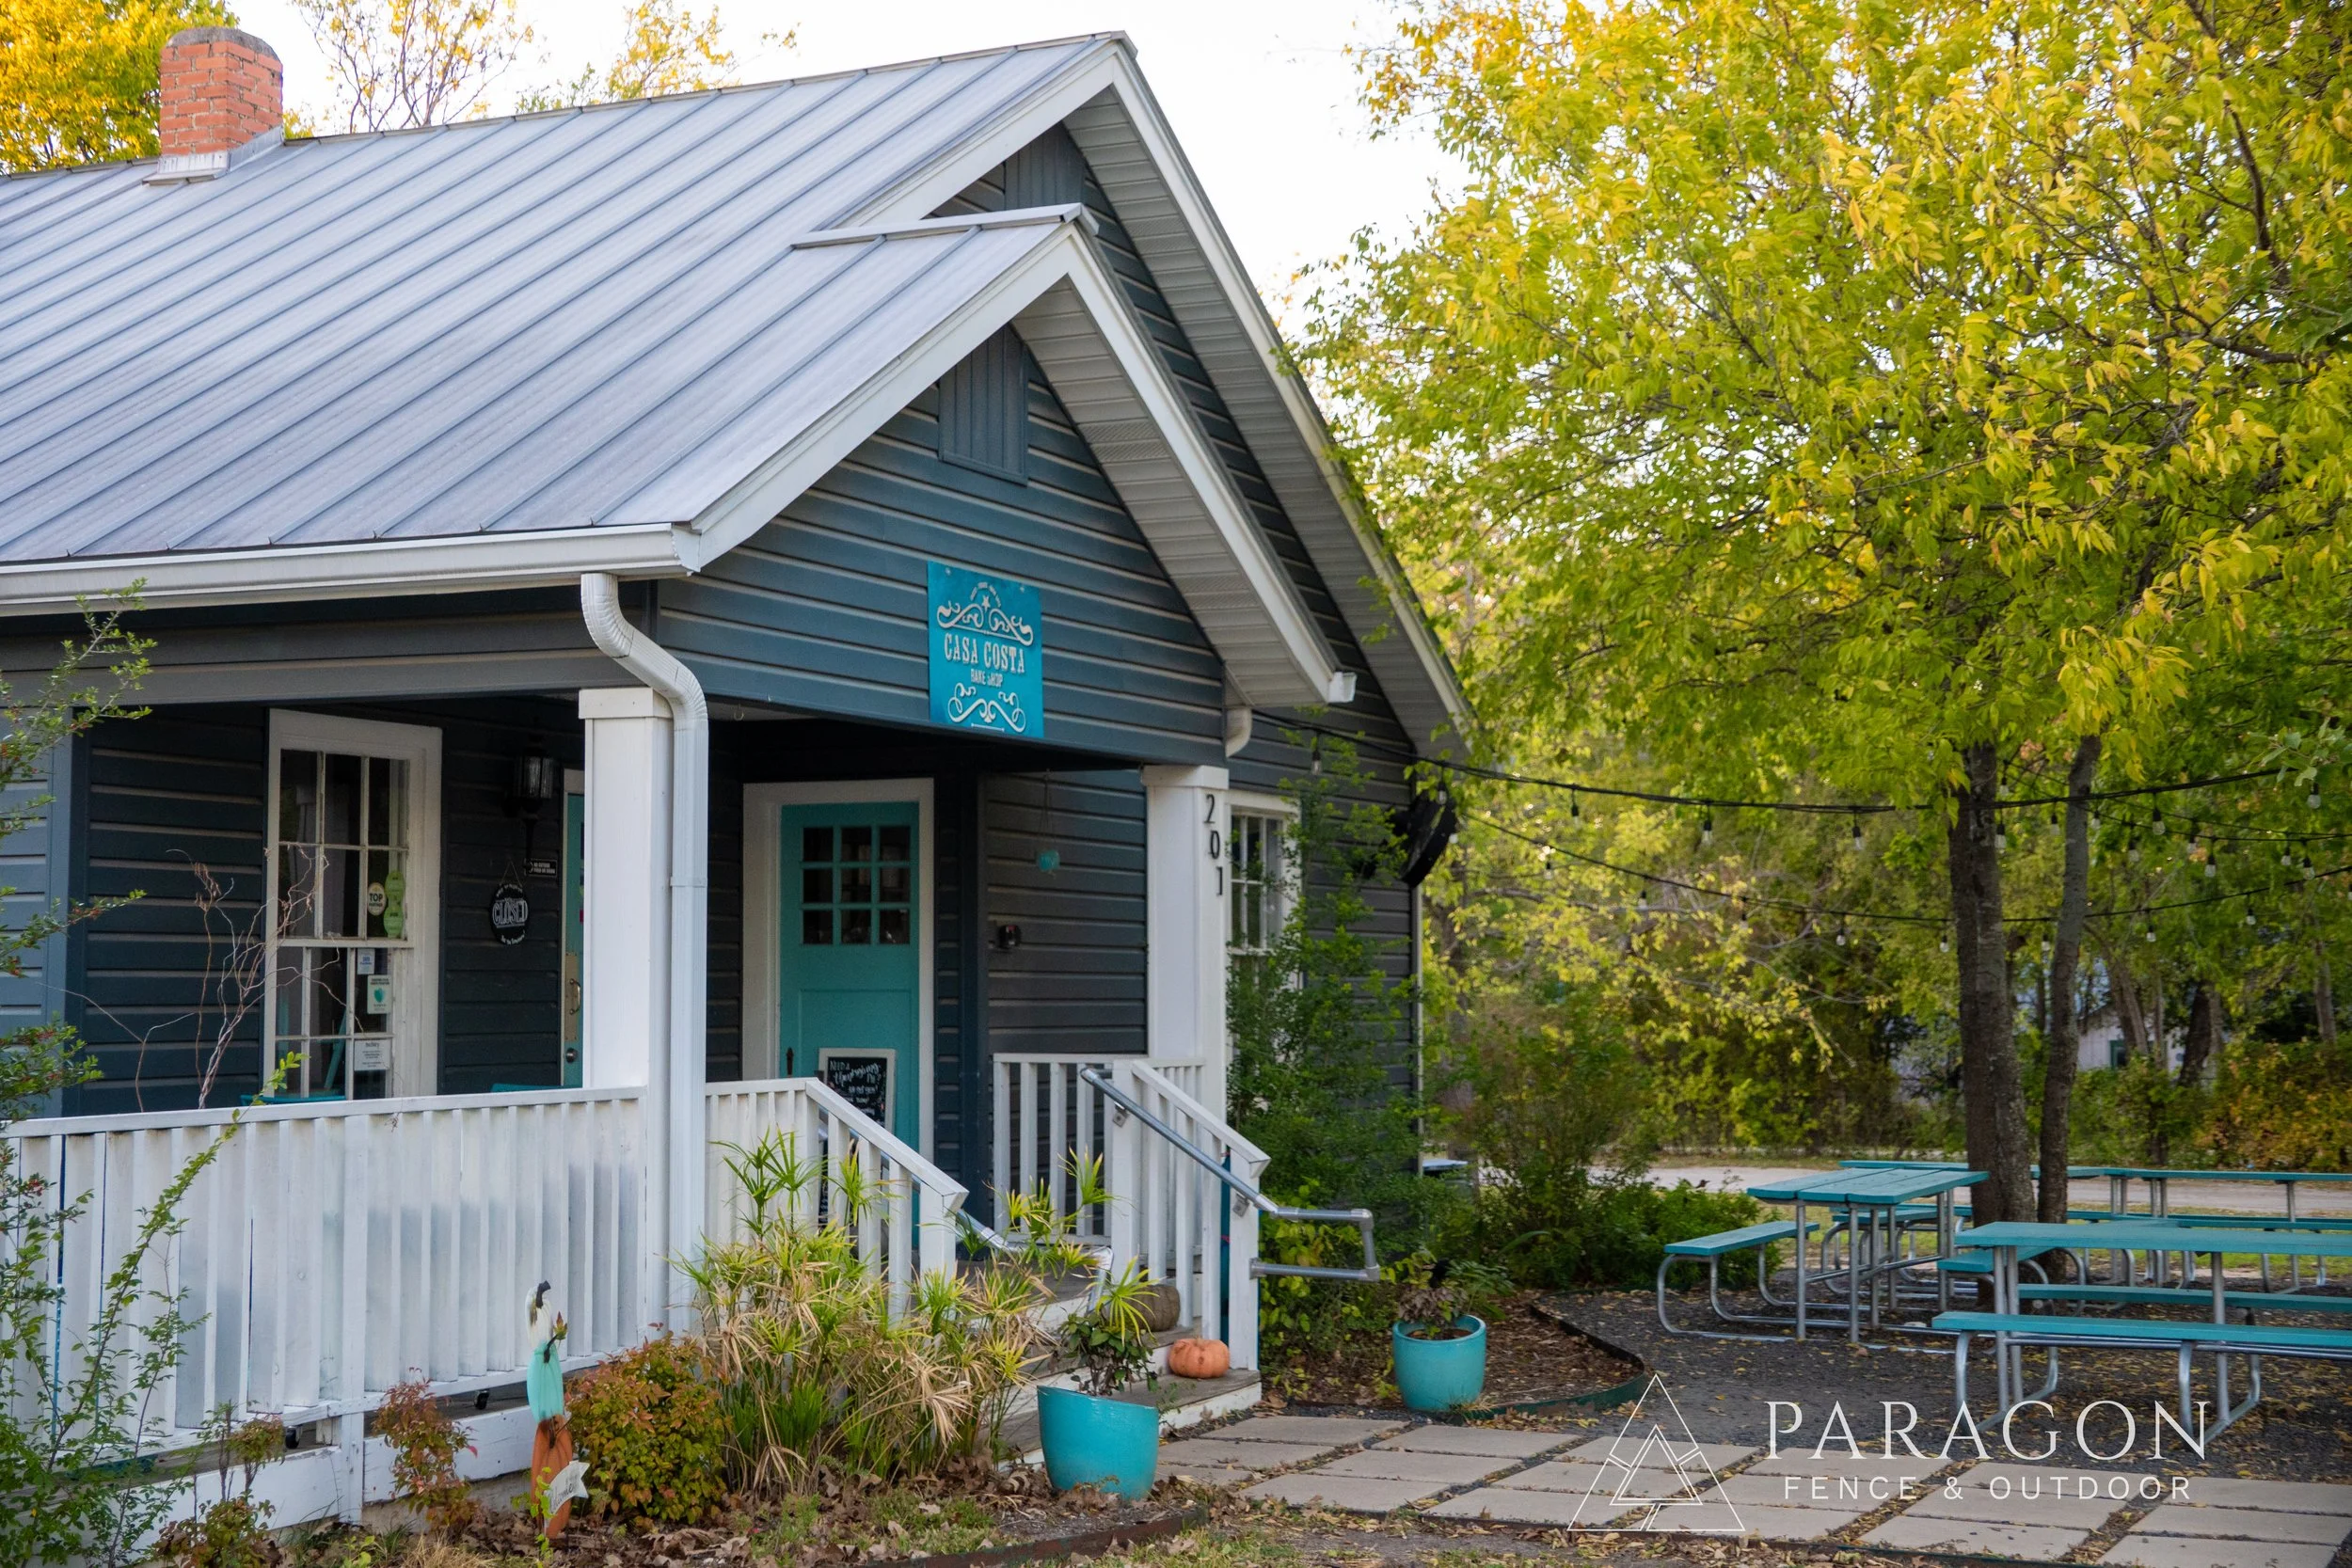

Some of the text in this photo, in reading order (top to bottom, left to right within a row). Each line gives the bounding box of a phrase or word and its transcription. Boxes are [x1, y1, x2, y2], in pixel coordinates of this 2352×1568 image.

[944, 632, 1025, 673] CASA COSTA
[971, 668, 986, 685] BAKE
[1203, 793, 1223, 896] 201
[370, 893, 384, 903] TOP
[492, 899, 529, 926] CLOSED
